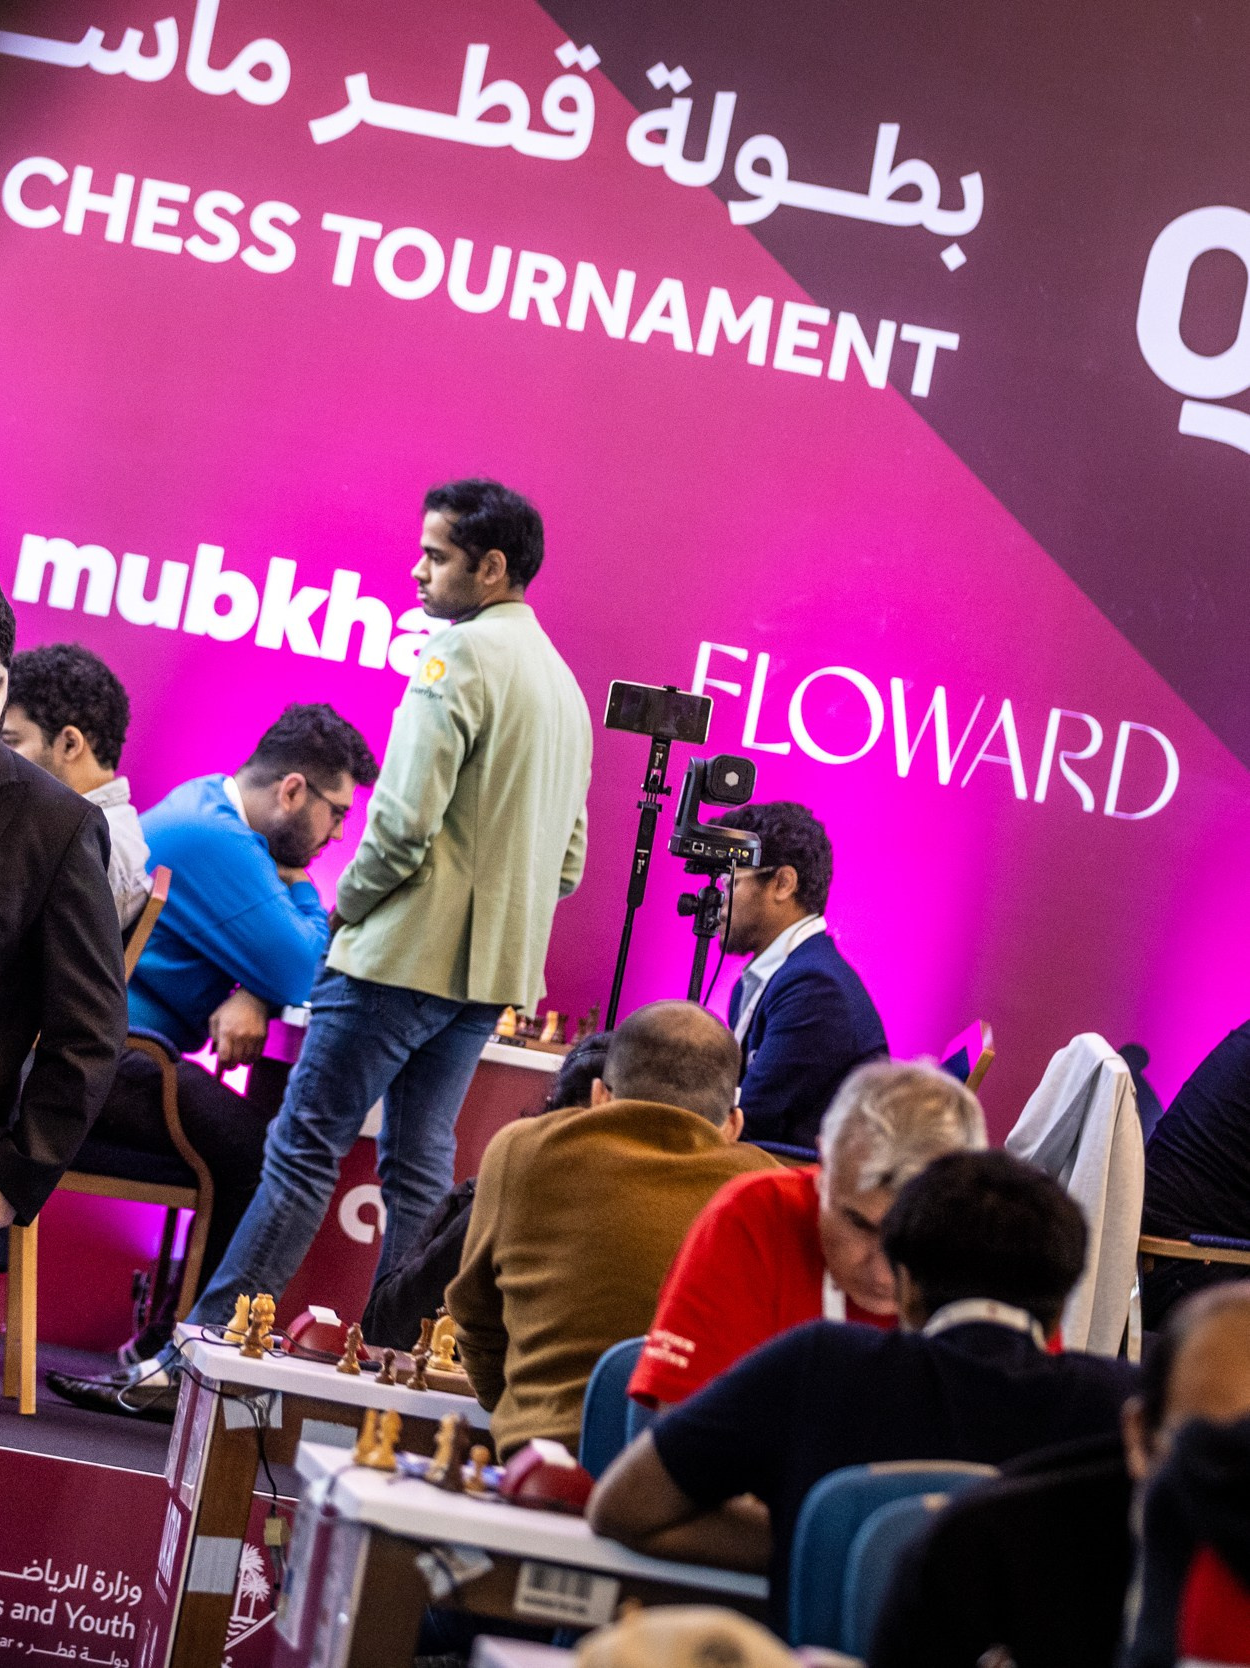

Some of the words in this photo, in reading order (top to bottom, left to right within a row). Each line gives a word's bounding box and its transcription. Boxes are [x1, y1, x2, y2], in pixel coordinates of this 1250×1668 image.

[308, 40, 601, 161] قطر
[626, 61, 985, 271] بطولة
[1, 156, 301, 275] CHESS
[321, 212, 960, 398] TOURNAMENT
[690, 640, 1180, 821] FLOWARD
[10, 1599, 57, 1626] and
[65, 1602, 136, 1640] Youth
[92, 1571, 144, 1607] وزارة
[26, 1641, 77, 1660] قطر
